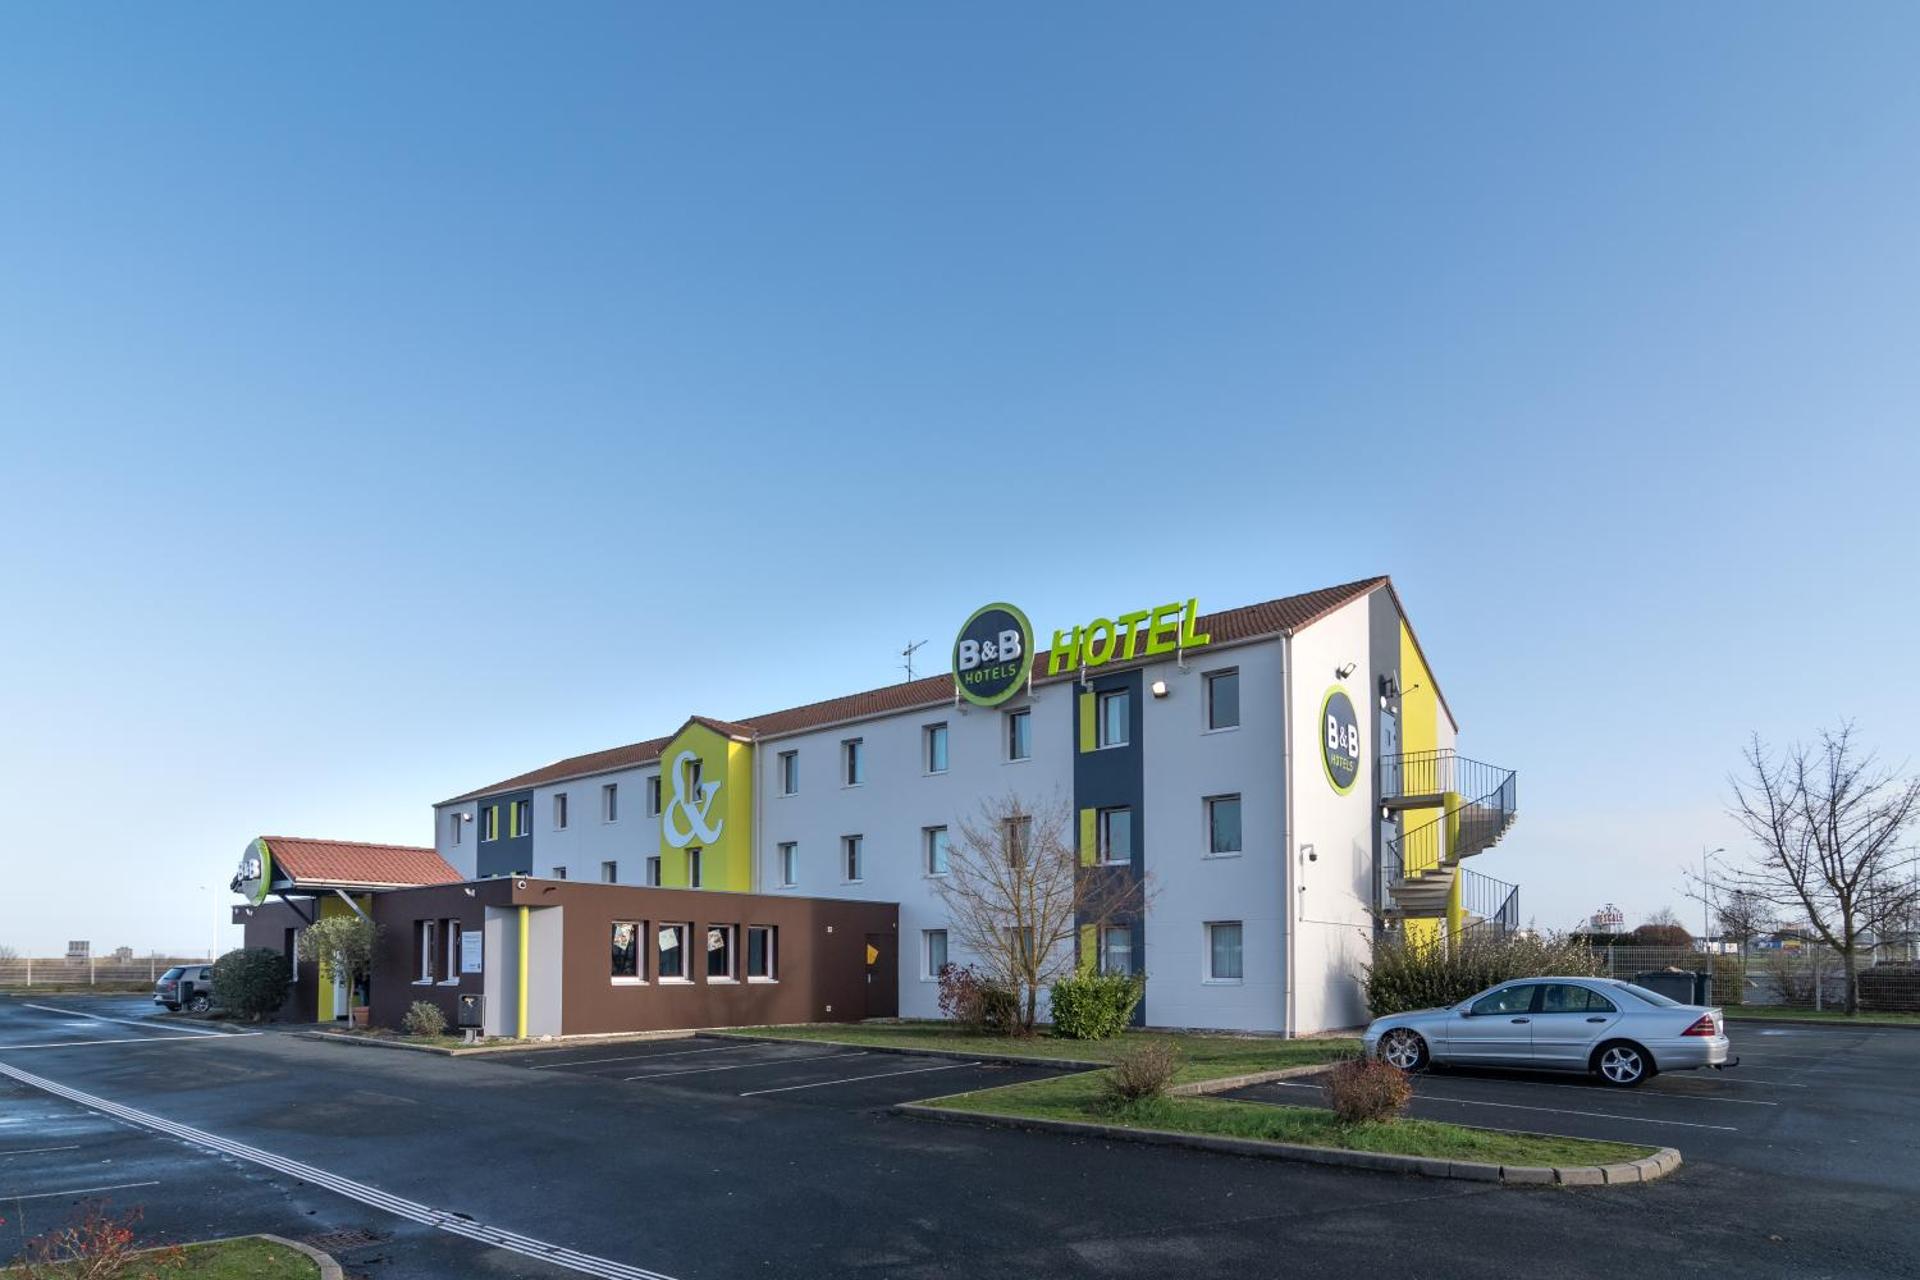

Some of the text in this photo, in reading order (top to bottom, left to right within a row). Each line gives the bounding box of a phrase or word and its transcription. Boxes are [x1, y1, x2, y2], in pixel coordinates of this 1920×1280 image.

[959, 629, 1021, 671] B&B
[1048, 597, 1210, 675] HOTEL
[965, 664, 1016, 684] HOTELS
[1328, 714, 1358, 758] B&B
[1331, 753, 1354, 772] HOTELS
[664, 750, 723, 848] &
[238, 858, 260, 881] B&B
